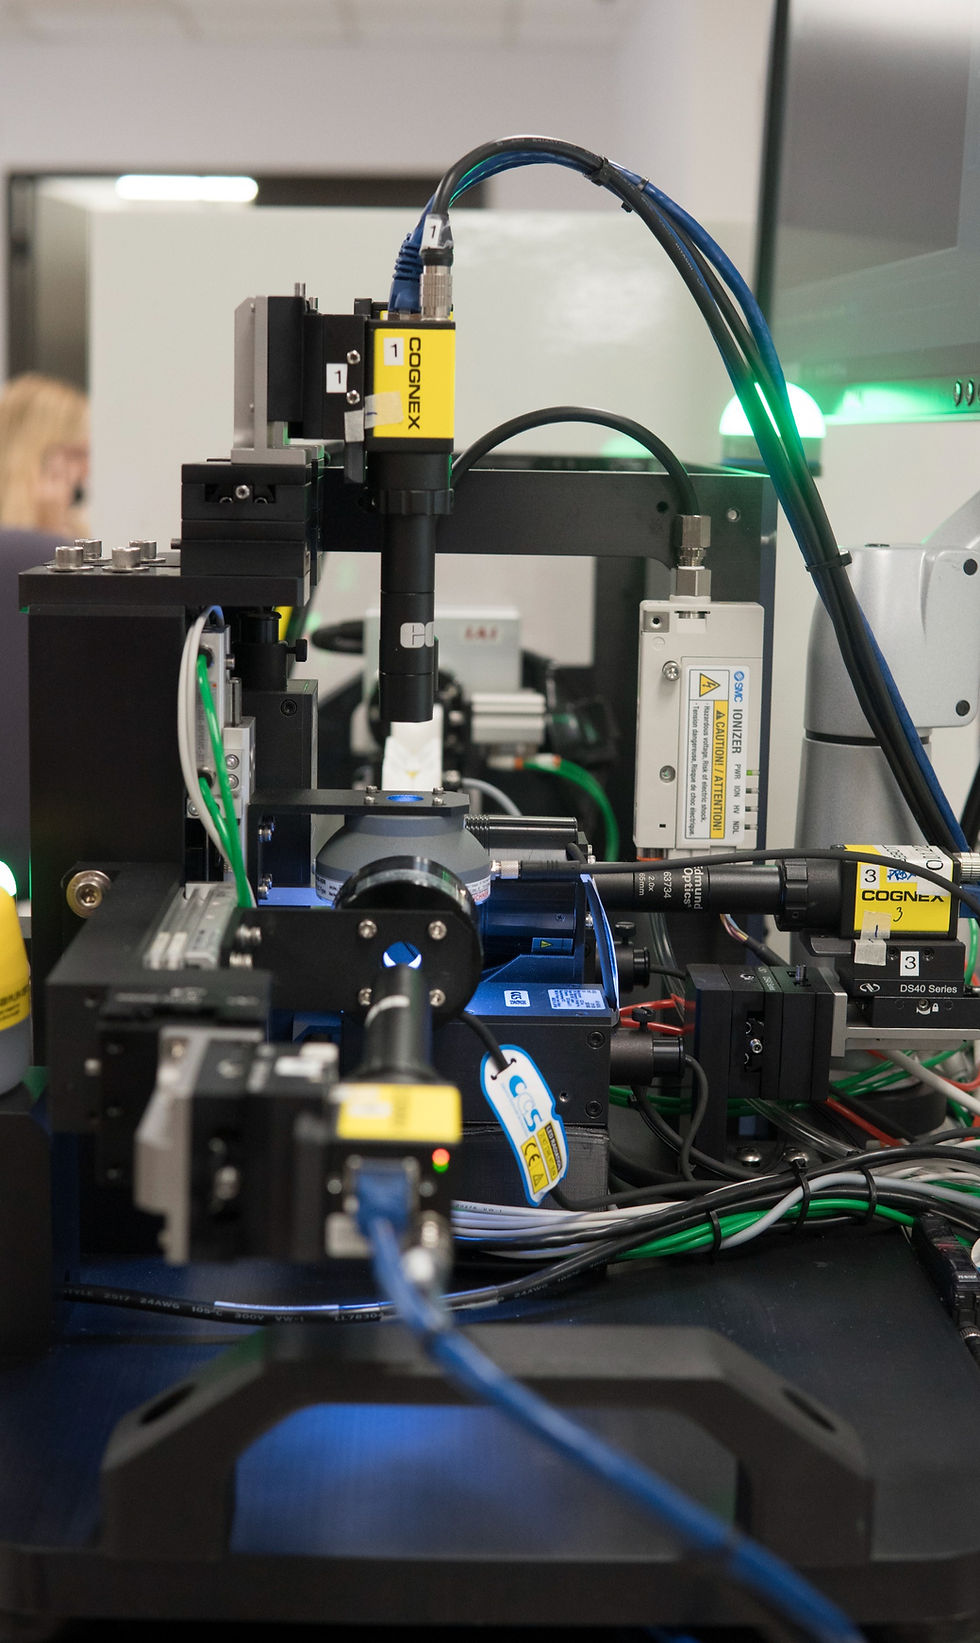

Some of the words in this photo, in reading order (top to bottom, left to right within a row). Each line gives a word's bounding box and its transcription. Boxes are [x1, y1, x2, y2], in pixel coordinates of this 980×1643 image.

[430, 225, 437, 239] 1
[390, 343, 398, 358] 1
[334, 370, 342, 385] 1
[408, 336, 422, 430] COGNEX
[733, 682, 744, 703] SMC
[732, 709, 743, 753] IONIZER
[714, 721, 726, 766] CAUTION!
[733, 763, 741, 780] PWR
[733, 785, 741, 798] ION
[712, 775, 724, 831] ATTENTION!
[733, 804, 740, 814] HV
[732, 820, 740, 835] NDL
[864, 869, 877, 883] 3
[638, 872, 646, 896] 65mm
[663, 871, 672, 899] 63734
[682, 867, 694, 905] Optics
[904, 956, 917, 970] 3
[900, 984, 926, 994] DS40
[928, 984, 958, 994] Series
[139, 1297, 181, 1310] 24AWG
